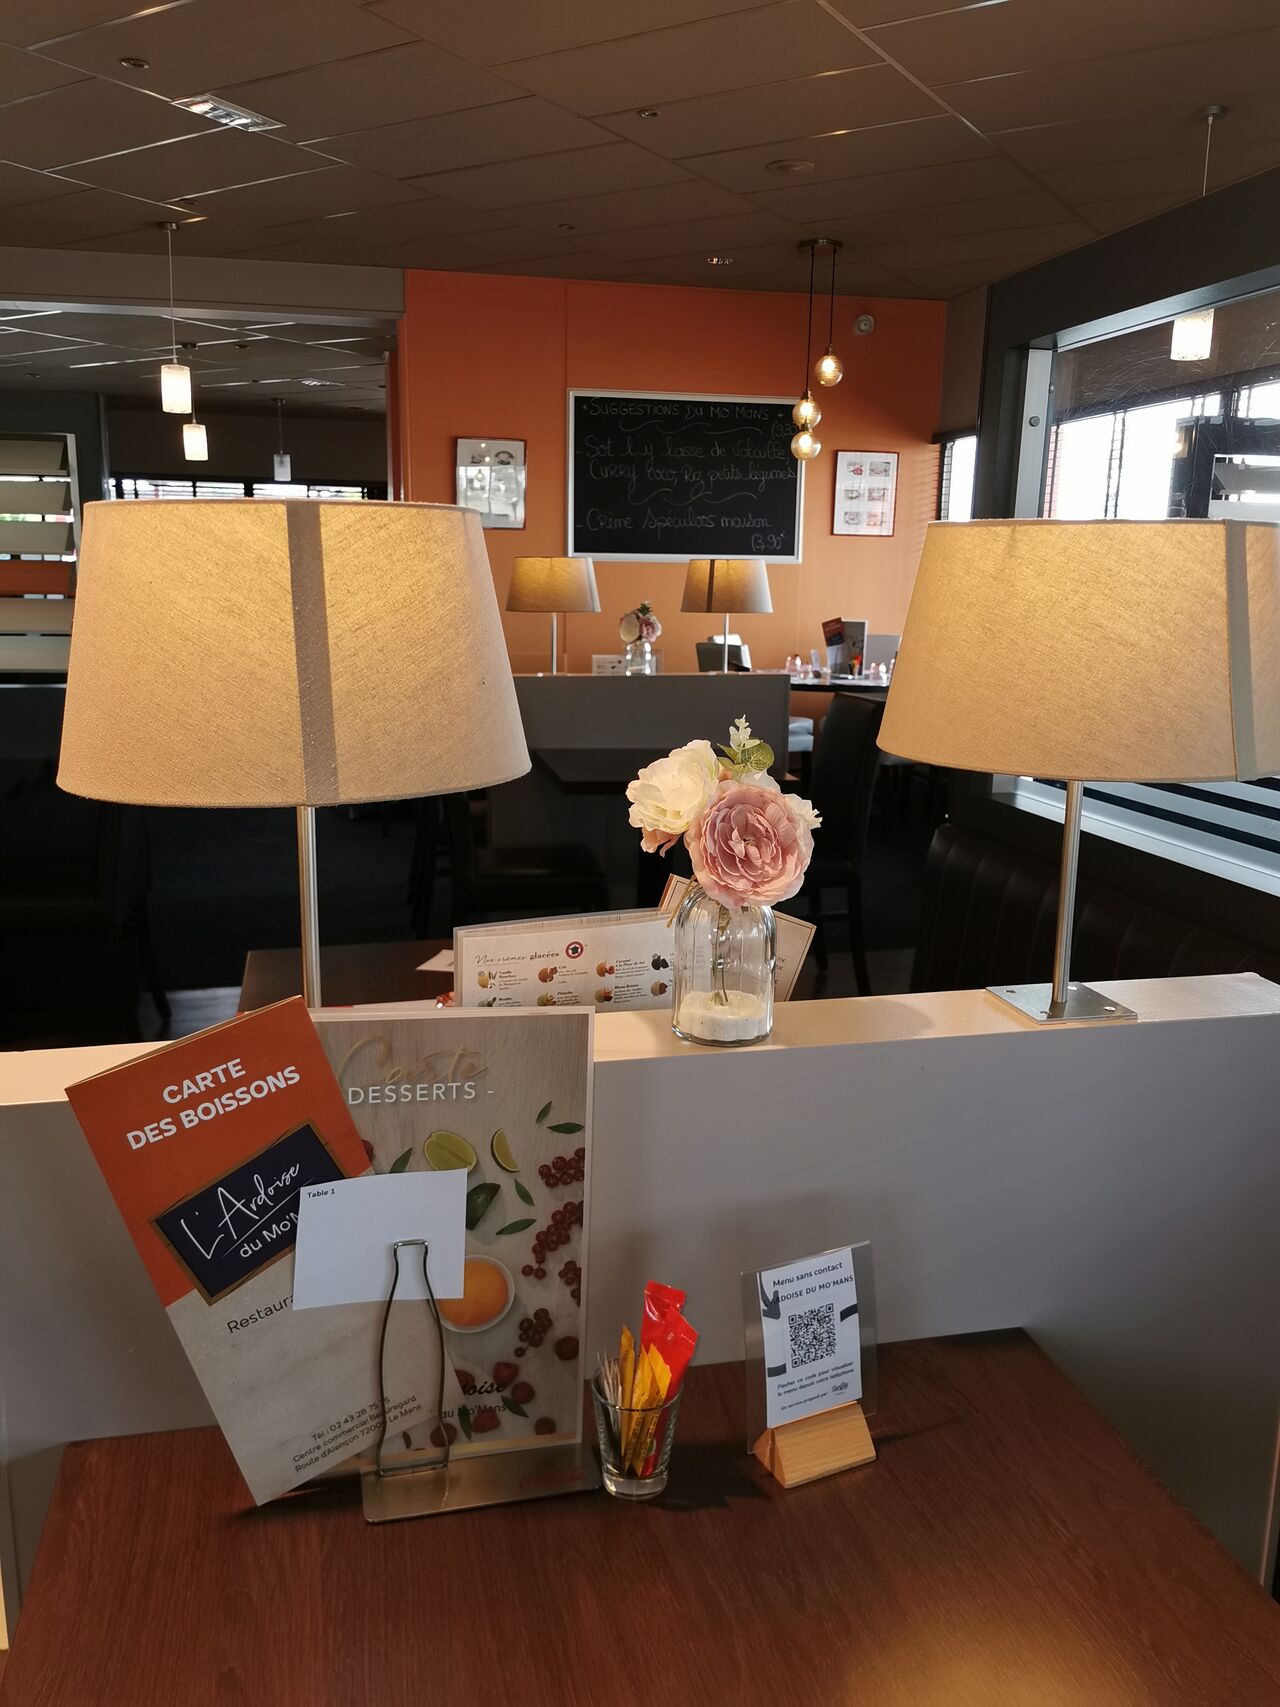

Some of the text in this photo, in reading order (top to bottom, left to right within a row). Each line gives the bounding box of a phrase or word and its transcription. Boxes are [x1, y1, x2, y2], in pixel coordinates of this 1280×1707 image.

[685, 405, 704, 421] DU
[710, 440, 728, 457] de
[162, 1058, 247, 1104] CARTE
[348, 1081, 477, 1105] DESSERTS
[126, 1066, 301, 1150] DES BOISSONS
[307, 1189, 329, 1199] Table
[180, 1163, 300, 1260] L'Ardoise
[239, 1239, 263, 1258] du
[773, 1262, 843, 1288] Menu sans contact
[806, 1286, 817, 1295] DU
[819, 1274, 854, 1291] MO'MANS
[292, 1394, 417, 1463] Centre commercial Beuregard
[329, 1421, 342, 1432] 02
[343, 1414, 355, 1425] 43
[356, 1408, 368, 1419] 28
[368, 1402, 380, 1412] 75
[294, 1456, 320, 1473] Route
[388, 1412, 399, 1423] Le
[399, 1403, 423, 1417] Mans
